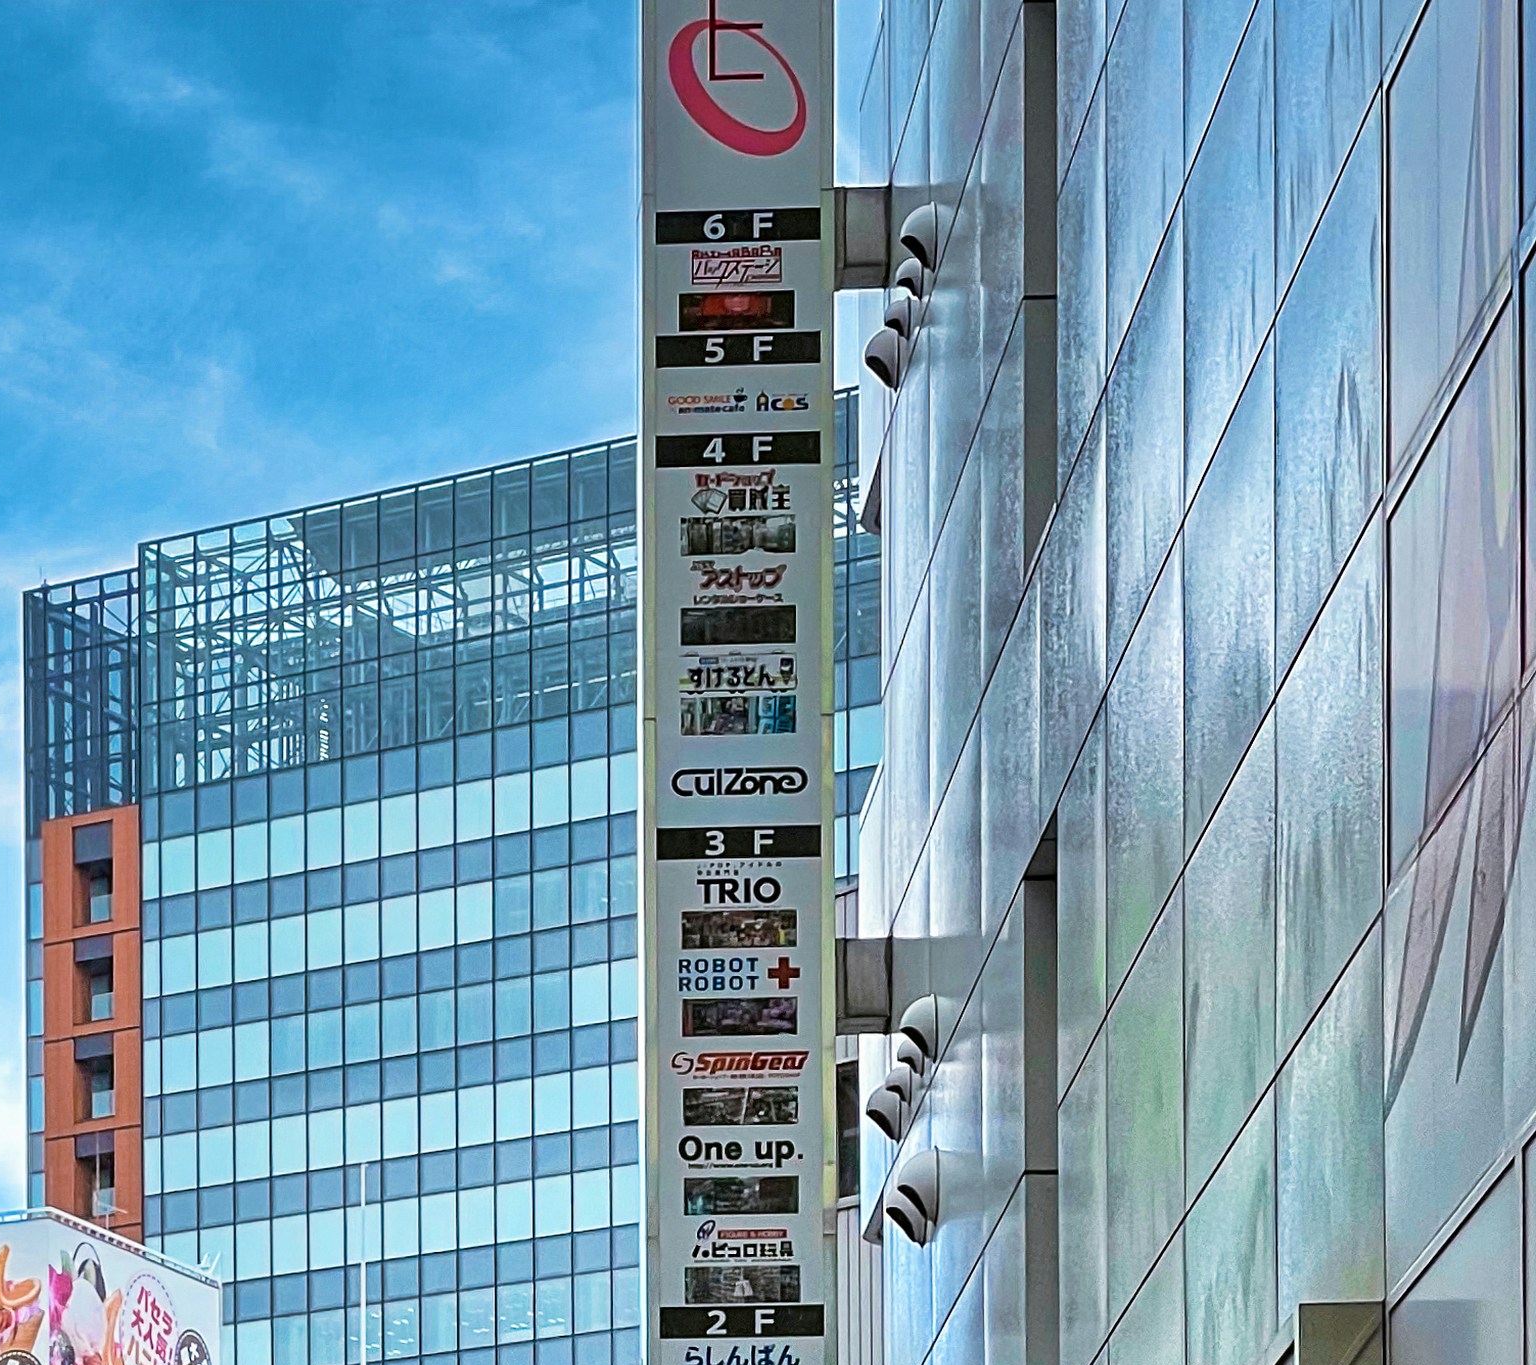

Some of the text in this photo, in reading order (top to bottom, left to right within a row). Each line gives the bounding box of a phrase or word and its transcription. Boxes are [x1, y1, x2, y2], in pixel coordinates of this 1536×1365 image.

[696, 877, 781, 904] TRIO
[678, 958, 759, 974] ROBOT
[678, 976, 759, 992] ROBOT
[678, 1136, 743, 1161] One
[137, 1286, 174, 1336] パセラ
